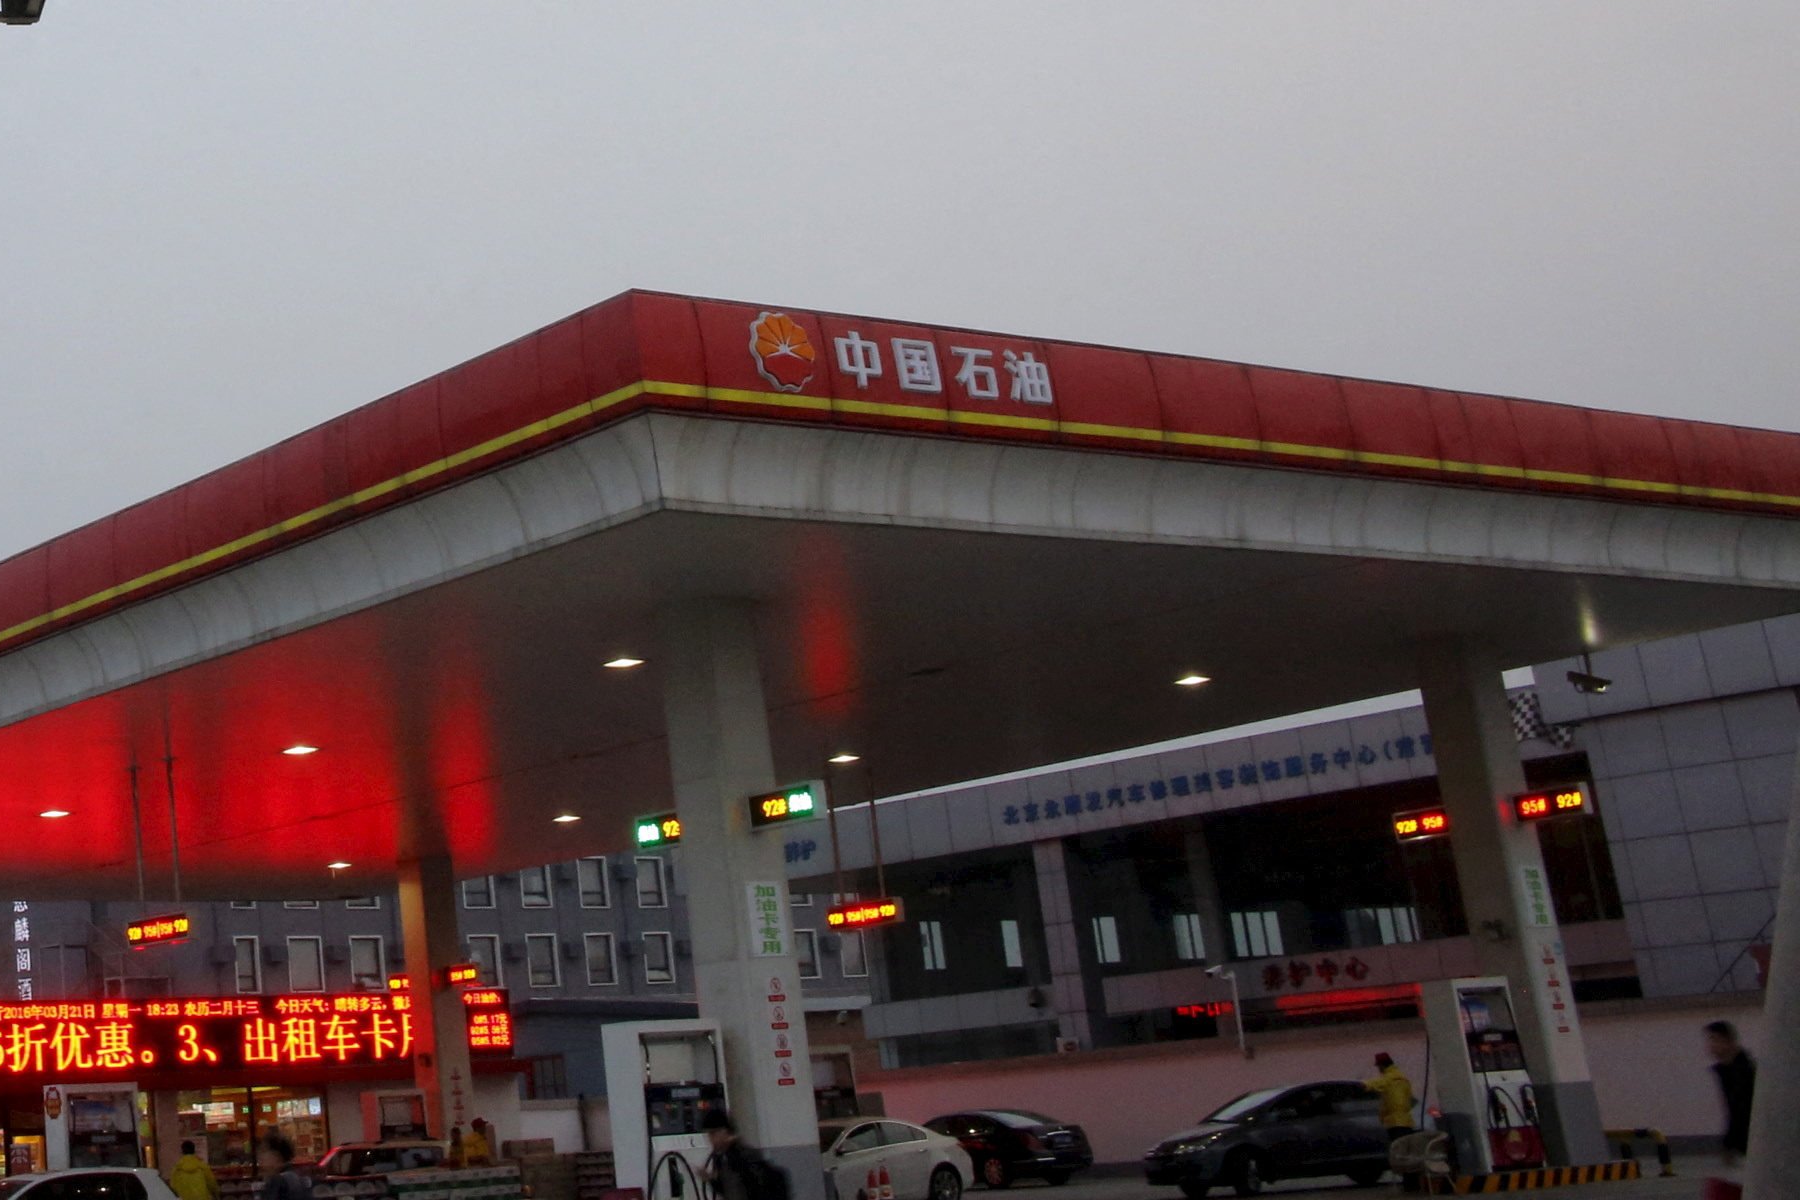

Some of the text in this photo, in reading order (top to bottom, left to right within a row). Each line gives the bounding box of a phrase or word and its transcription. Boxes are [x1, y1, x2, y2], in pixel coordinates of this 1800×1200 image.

[834, 331, 1053, 404] 中国石油
[663, 820, 680, 837] 92
[754, 885, 782, 954] 加油卡专用
